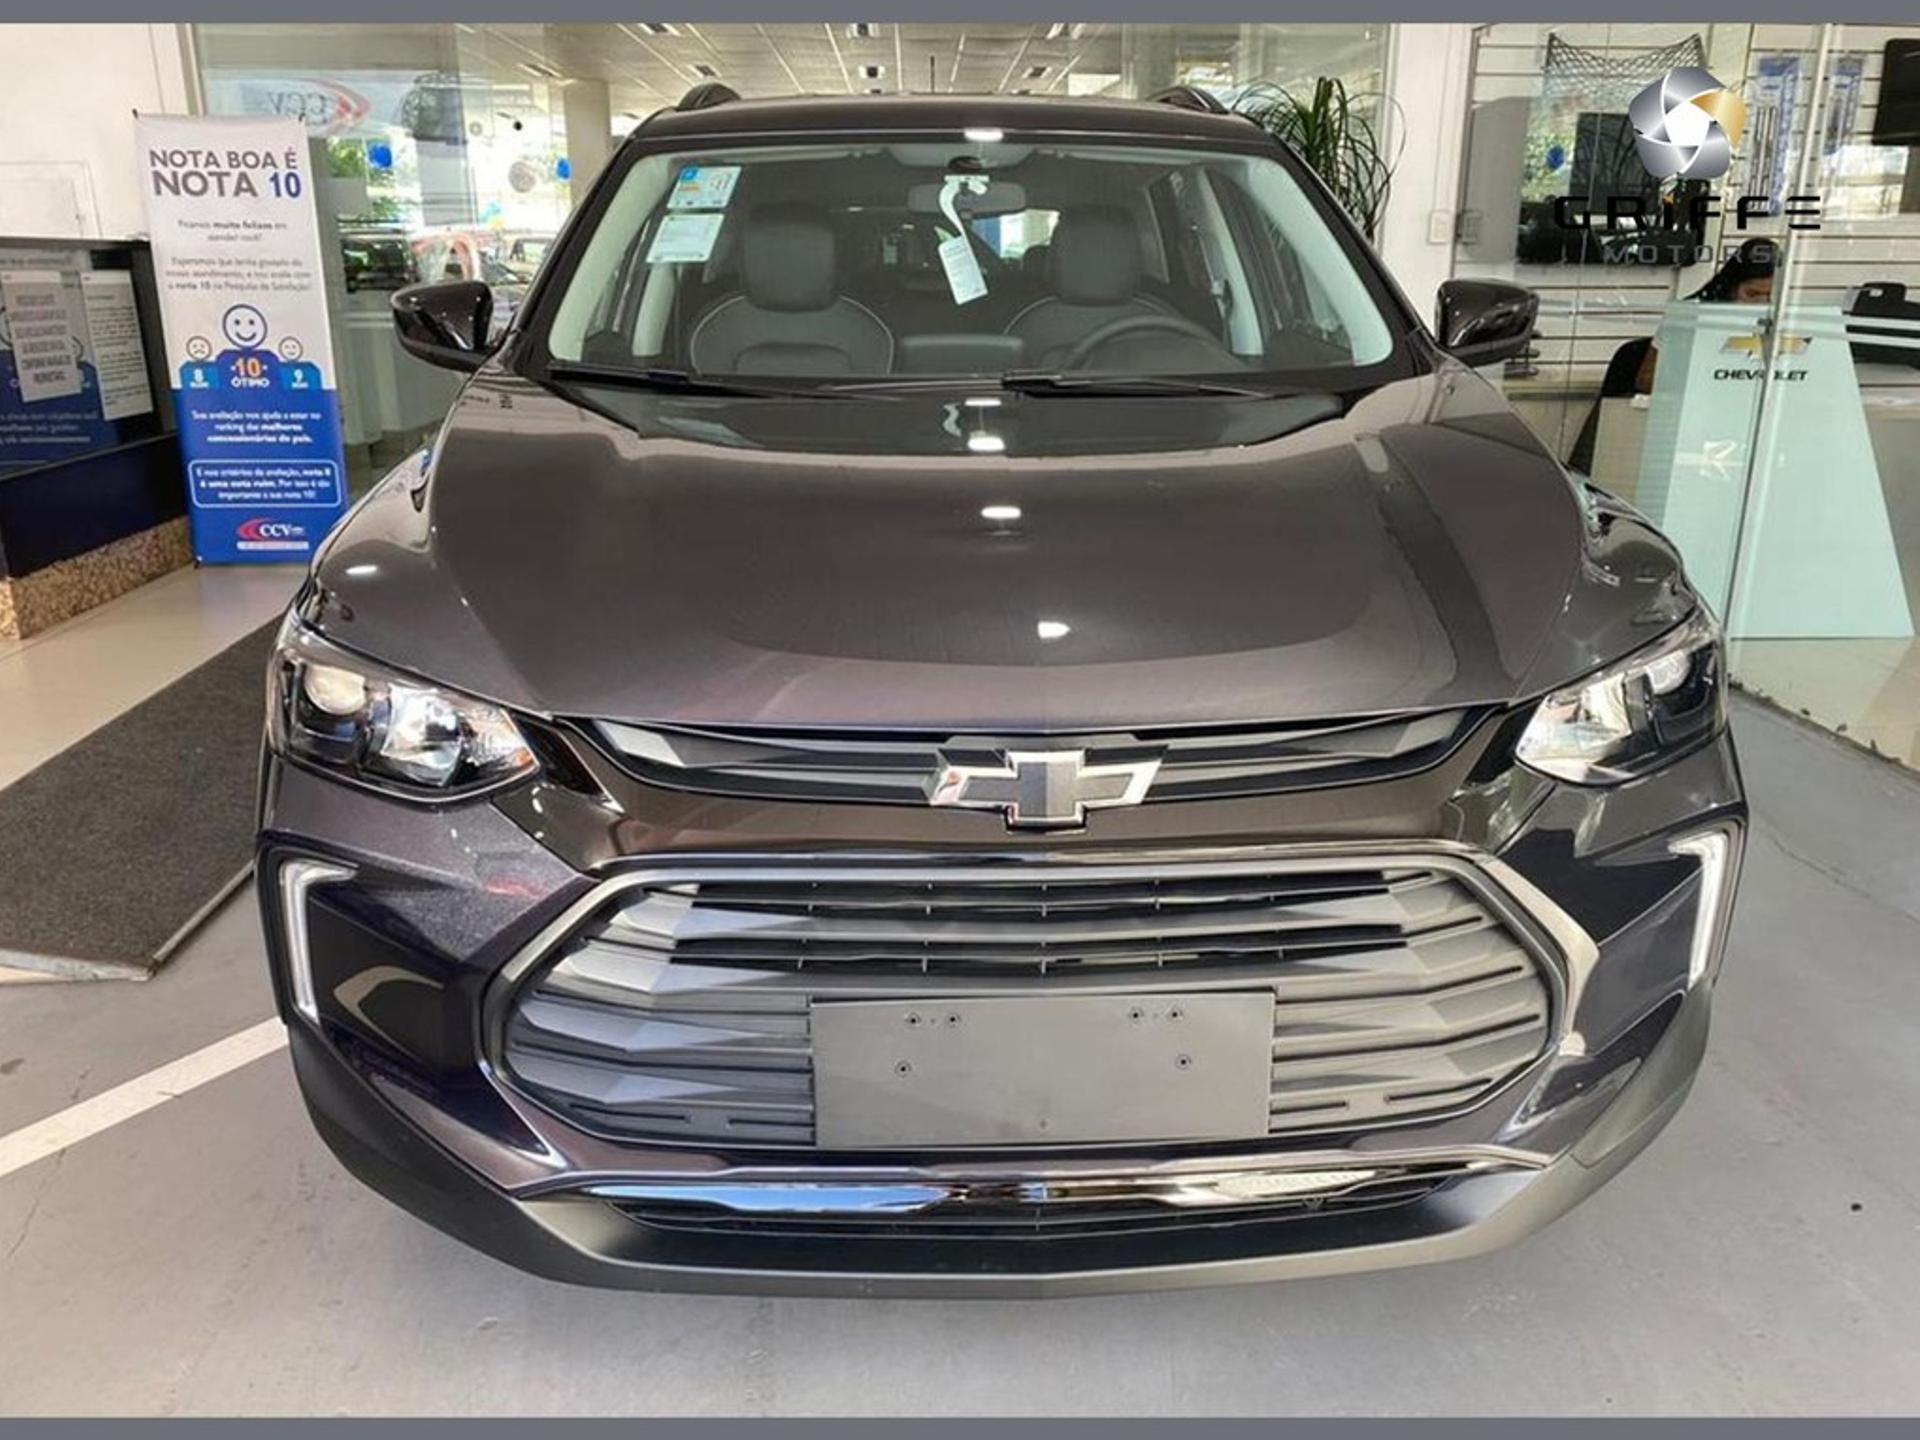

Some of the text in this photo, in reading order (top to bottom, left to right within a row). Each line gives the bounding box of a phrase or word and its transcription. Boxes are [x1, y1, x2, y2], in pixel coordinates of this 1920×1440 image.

[149, 147, 298, 170] NOTA BOA É
[152, 170, 302, 198] NOTA 10
[213, 221, 241, 229] muito
[193, 368, 204, 381] 8
[235, 358, 260, 378] 10
[231, 375, 270, 388] ÓTIMO
[293, 369, 304, 383] 9
[1714, 369, 1808, 381] CHEVLET
[260, 524, 292, 537] CCV
